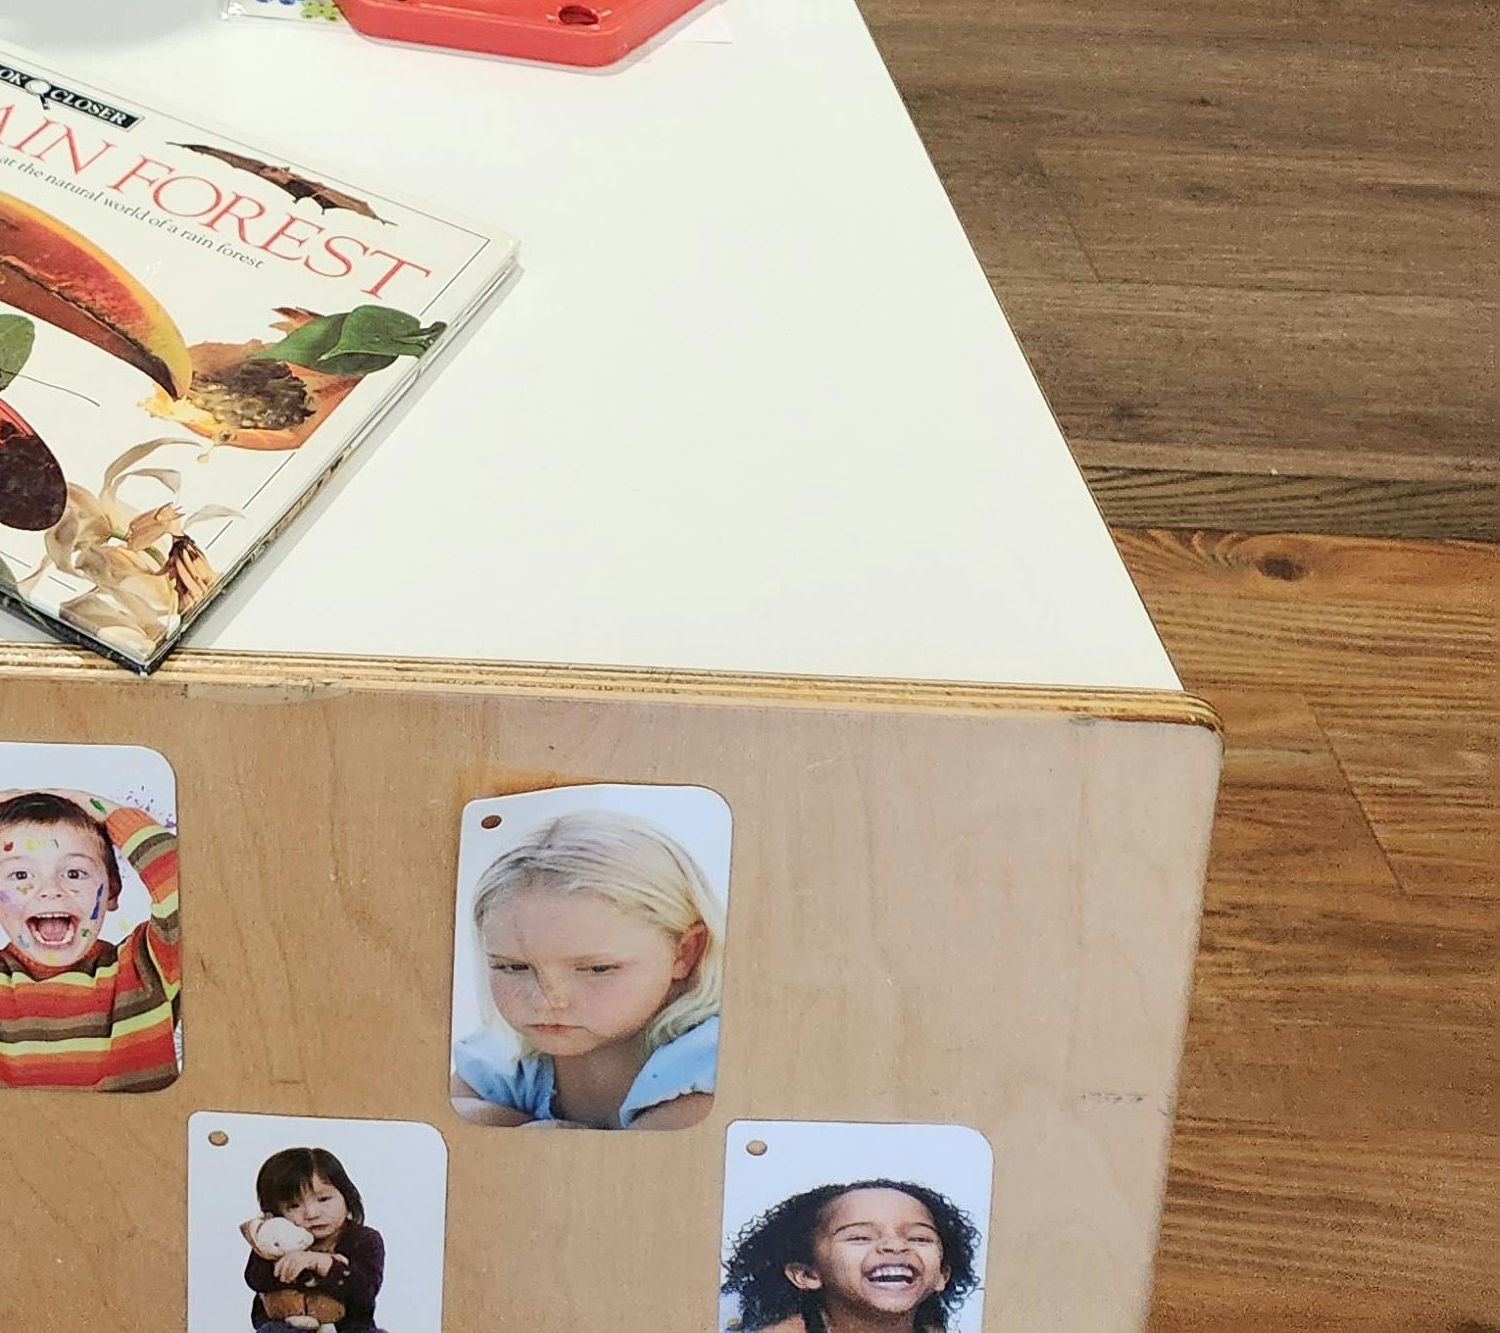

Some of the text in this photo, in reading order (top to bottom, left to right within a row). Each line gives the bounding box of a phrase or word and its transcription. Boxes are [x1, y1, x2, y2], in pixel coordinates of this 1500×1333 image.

[50, 88, 128, 127] CLOSER
[17, 161, 45, 179] the
[44, 173, 103, 203] natural
[103, 196, 150, 222] world
[148, 213, 171, 229] of
[179, 229, 214, 250] rain
[215, 241, 265, 270] forest
[108, 155, 432, 299] FOREST
